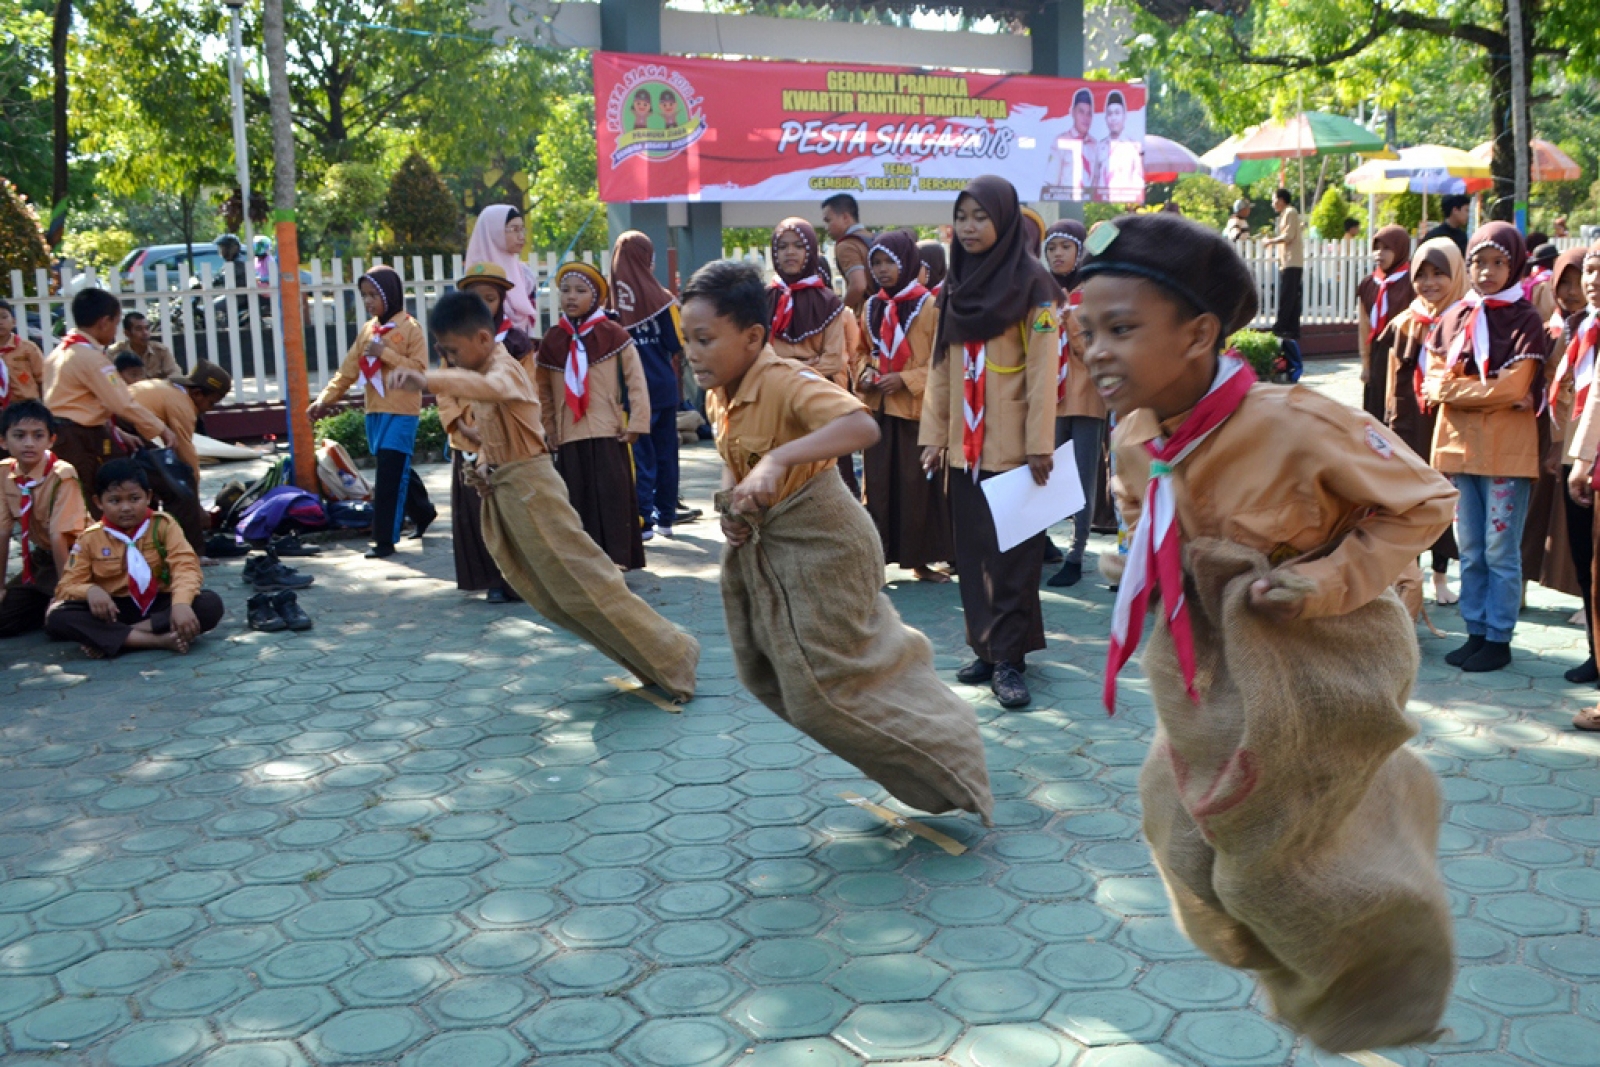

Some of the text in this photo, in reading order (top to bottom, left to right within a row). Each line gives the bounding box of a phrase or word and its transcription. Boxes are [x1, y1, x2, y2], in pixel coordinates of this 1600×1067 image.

[827, 71, 969, 97] GERAKAN PRAMUKA
[607, 84, 626, 131] PESTA
[623, 65, 668, 88] SIAGA
[782, 90, 1008, 119] KWARTIR RANTING MARTAPURA
[777, 119, 1014, 159] PESTA SIAGA 2018
[883, 162, 912, 176] TEMA
[808, 175, 864, 192] GEMBIRA,
[866, 176, 911, 190] KREATIF
